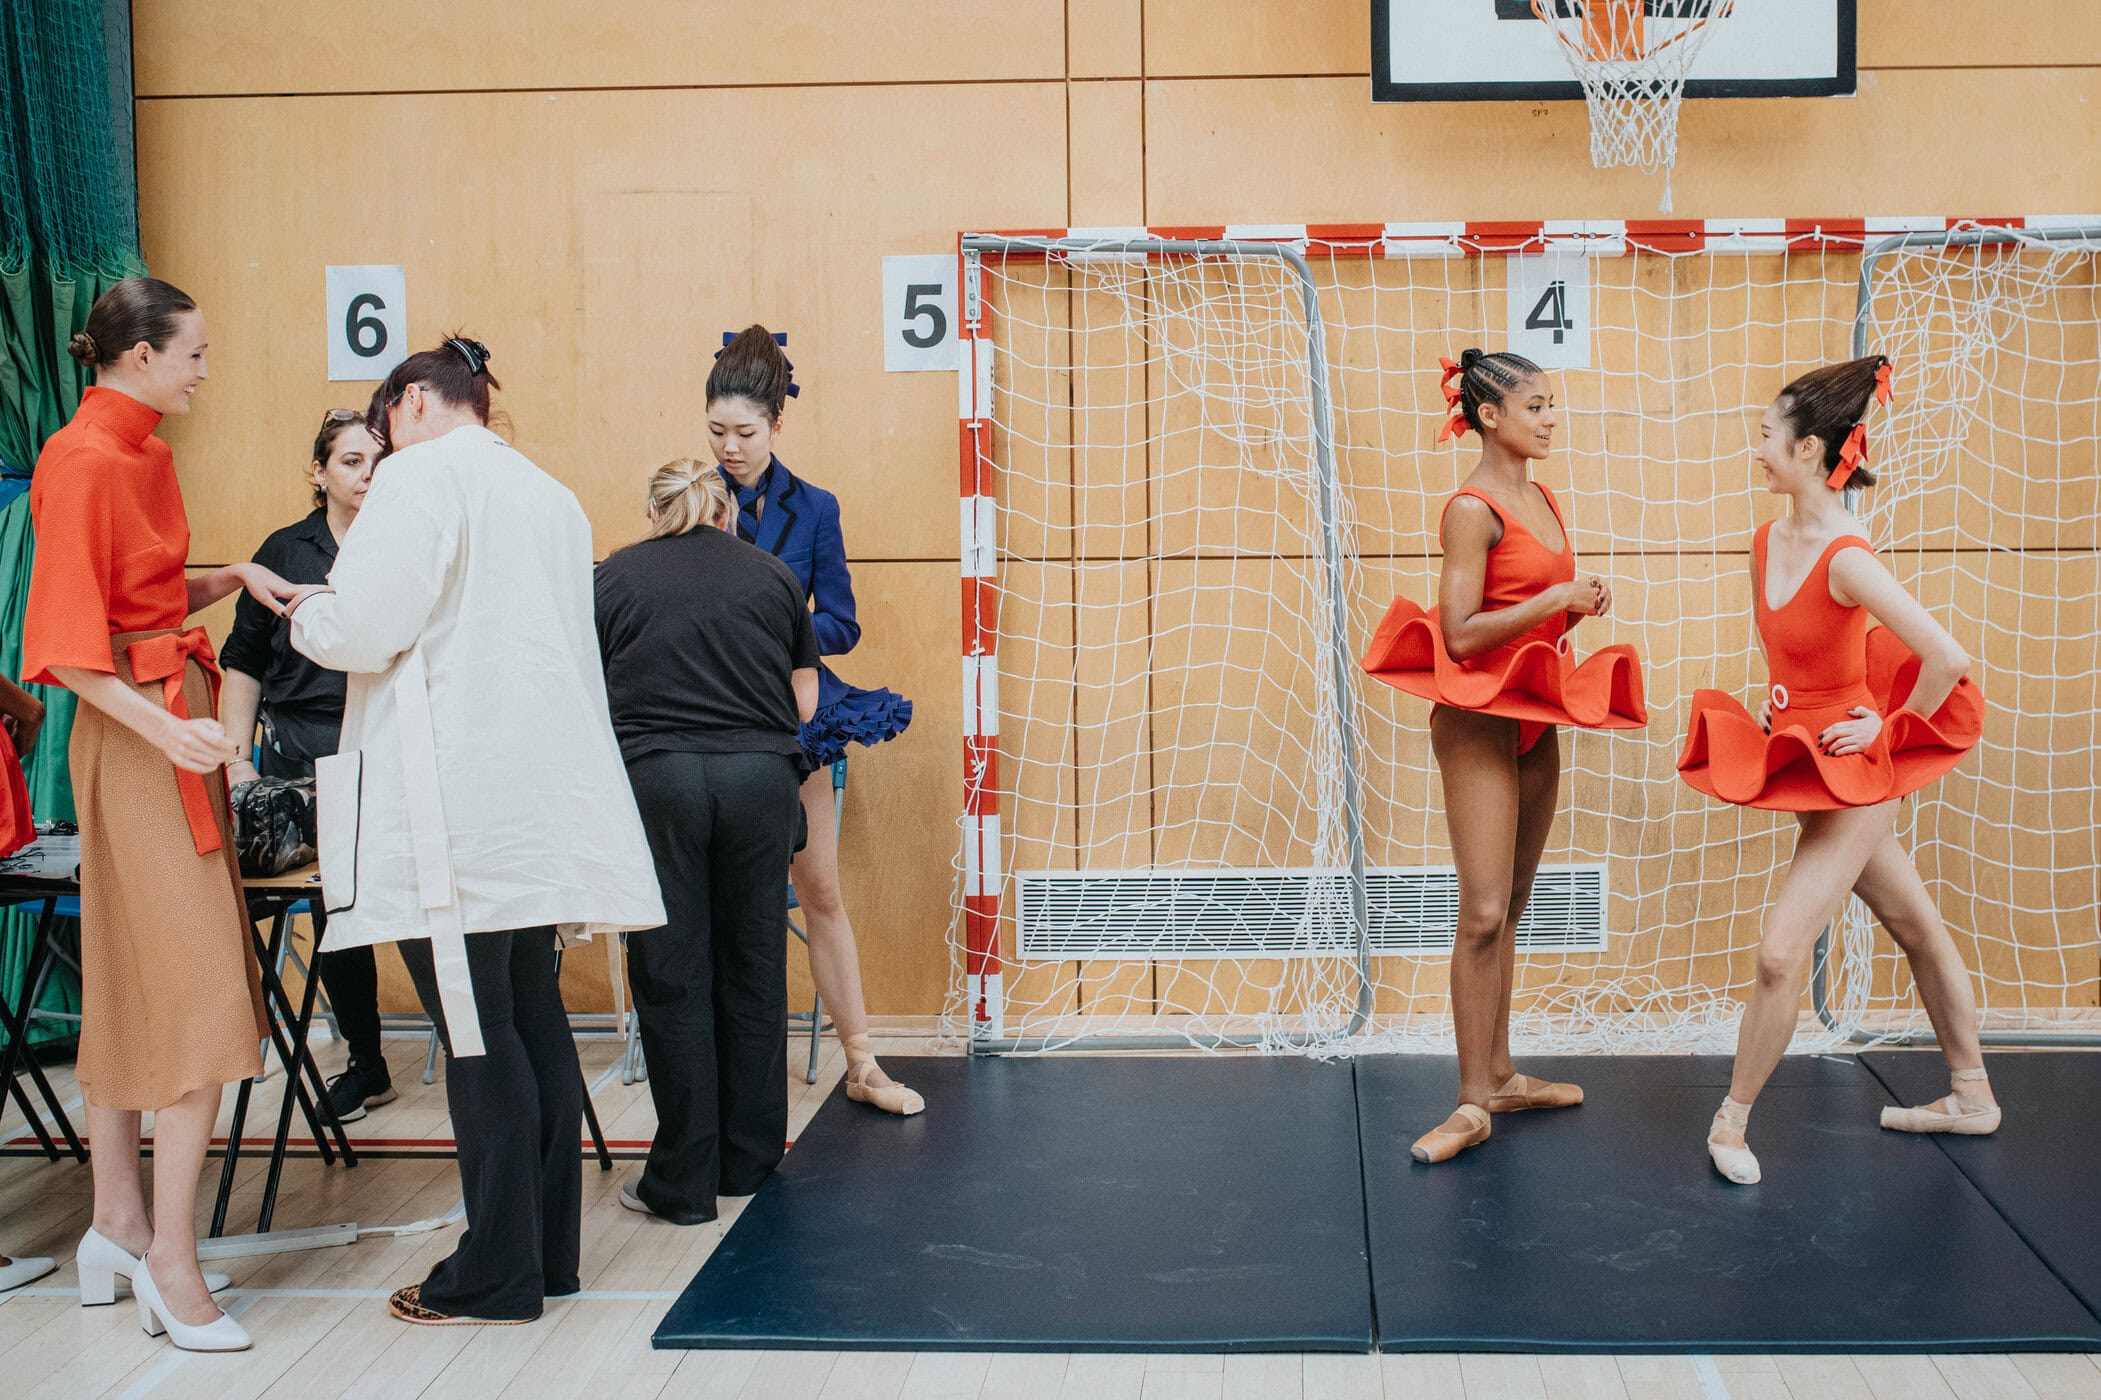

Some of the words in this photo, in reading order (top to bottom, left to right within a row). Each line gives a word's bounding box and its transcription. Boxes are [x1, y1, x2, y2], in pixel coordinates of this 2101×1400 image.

[346, 293, 388, 358] 6
[902, 284, 947, 348] 5
[1525, 280, 1573, 344] 4
